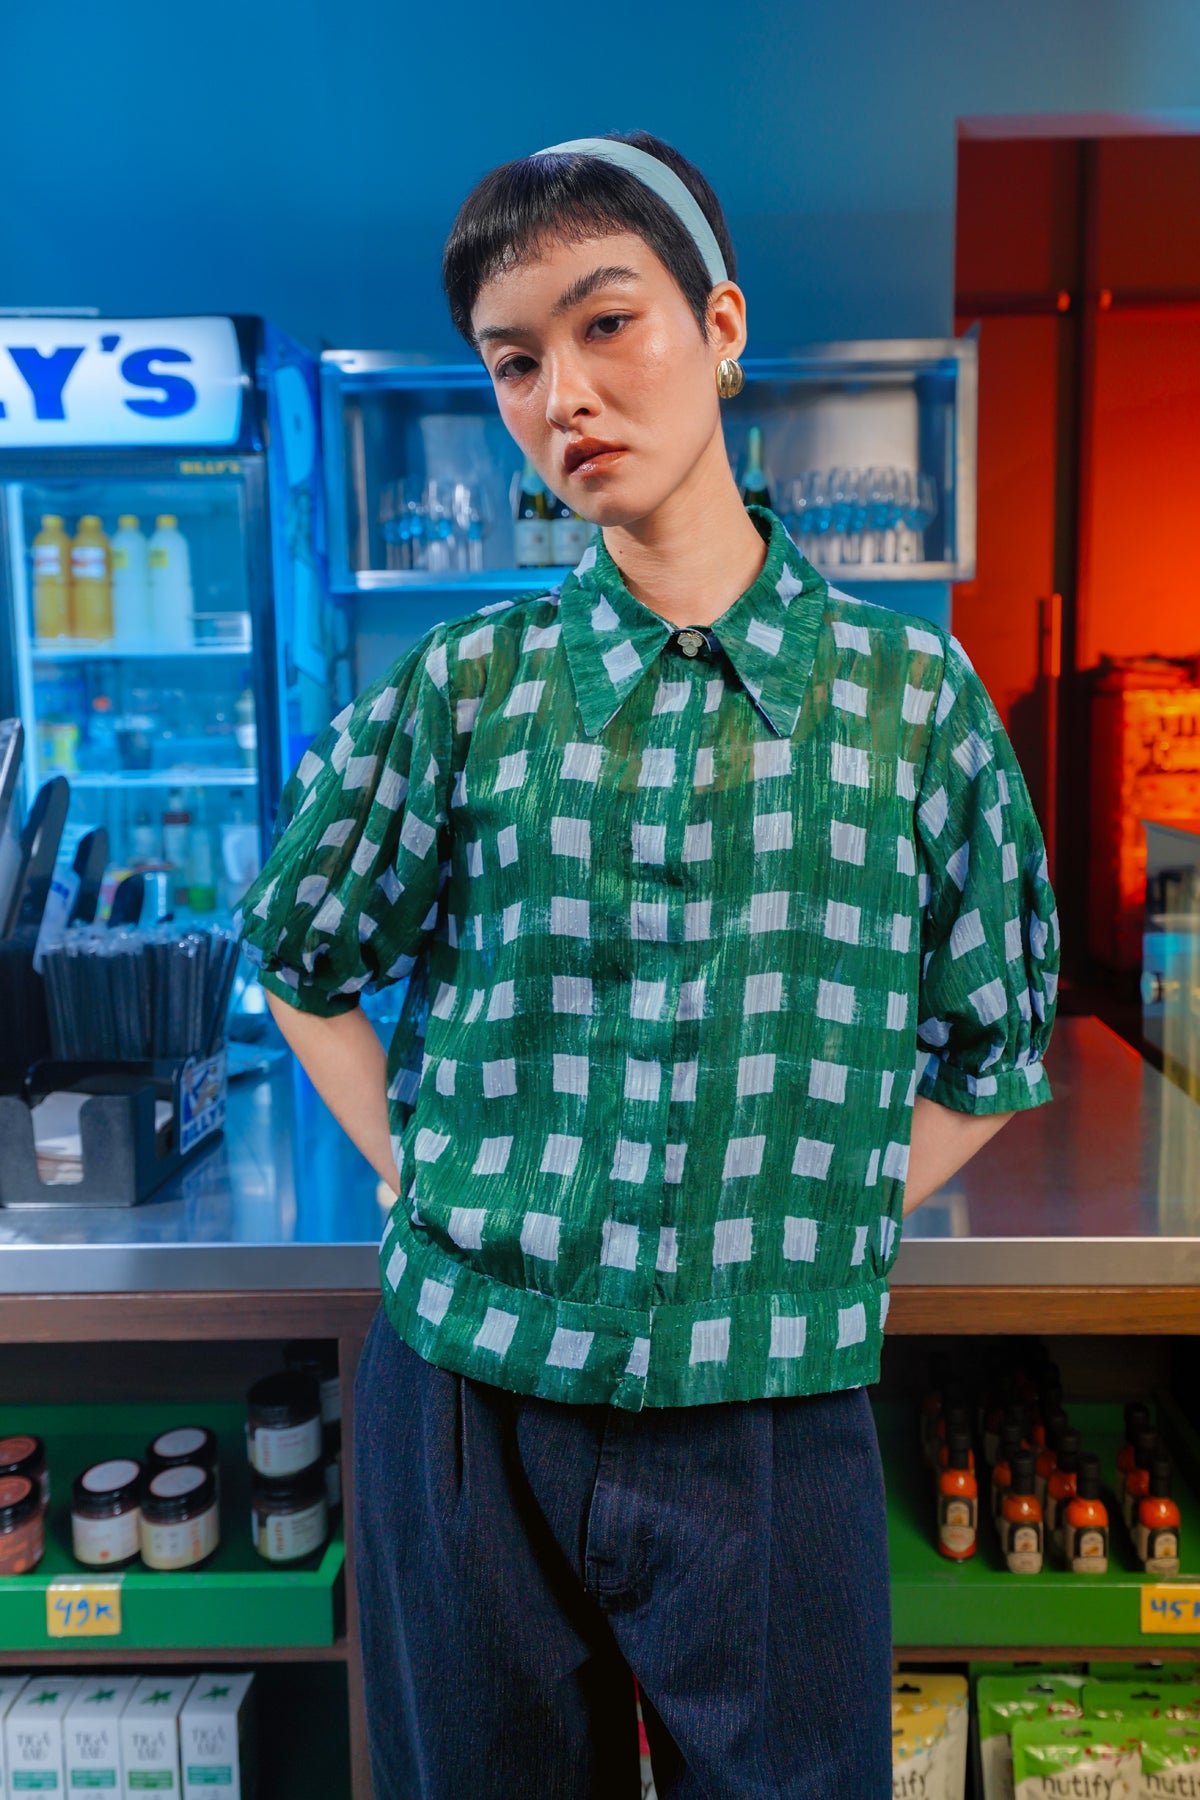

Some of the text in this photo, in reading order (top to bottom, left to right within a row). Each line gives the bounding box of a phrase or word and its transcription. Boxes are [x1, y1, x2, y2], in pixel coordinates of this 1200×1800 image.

[0, 335, 197, 421] Y'S
[1042, 1773, 1116, 1800] nutify
[1146, 1773, 1200, 1799] nuti
